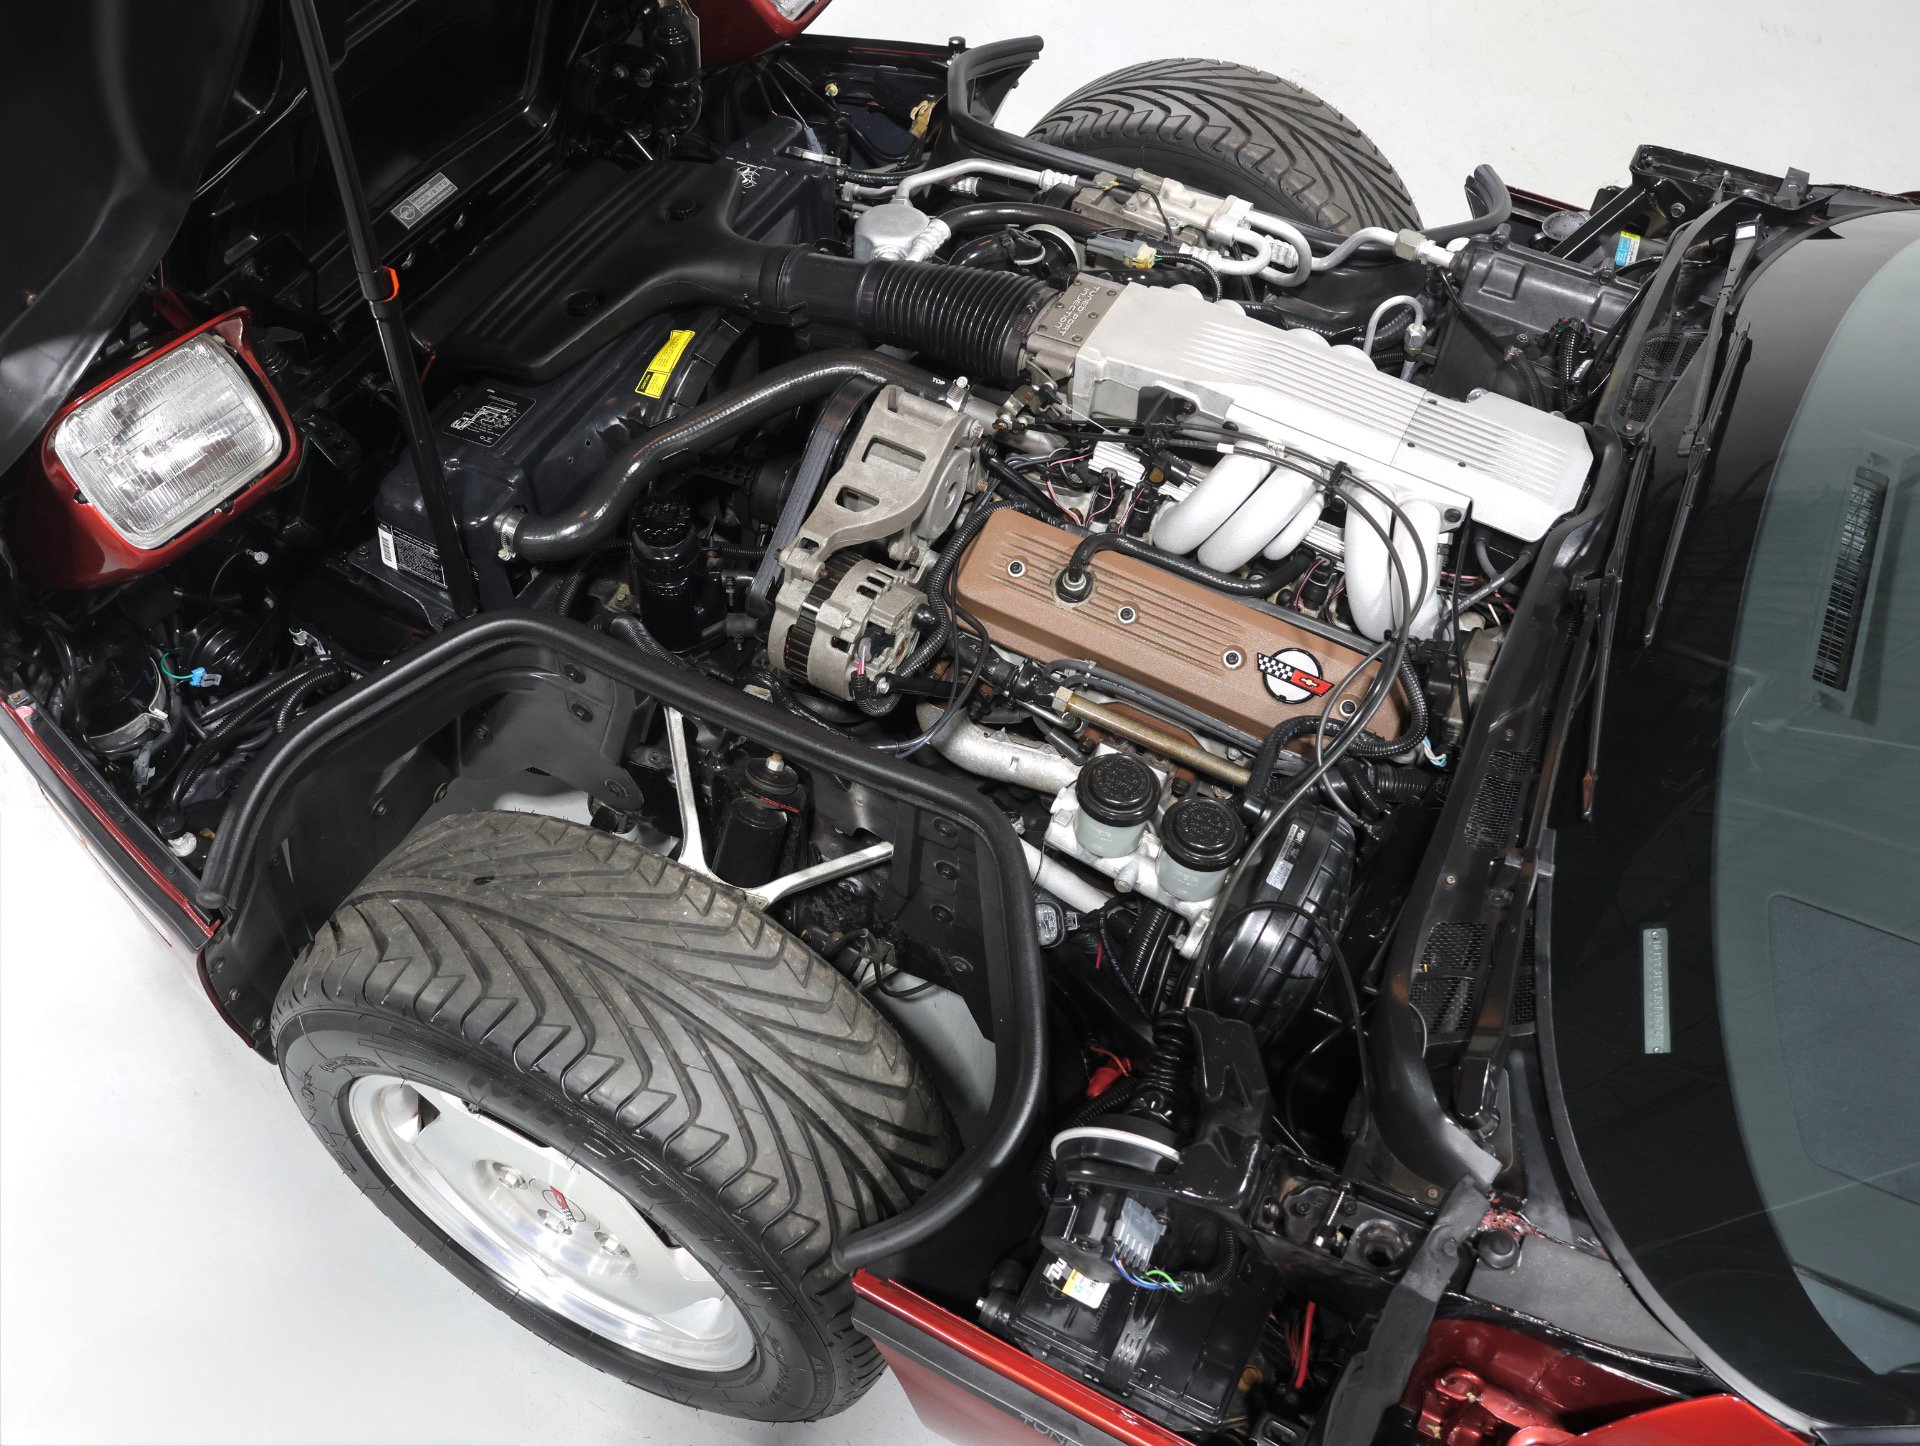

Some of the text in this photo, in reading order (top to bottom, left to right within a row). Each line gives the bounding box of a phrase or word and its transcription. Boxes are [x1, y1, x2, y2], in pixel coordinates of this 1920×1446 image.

[1054, 288, 1090, 329] INJECTION
[1059, 286, 1101, 336] TUNED PORT
[932, 376, 946, 386] TOP
